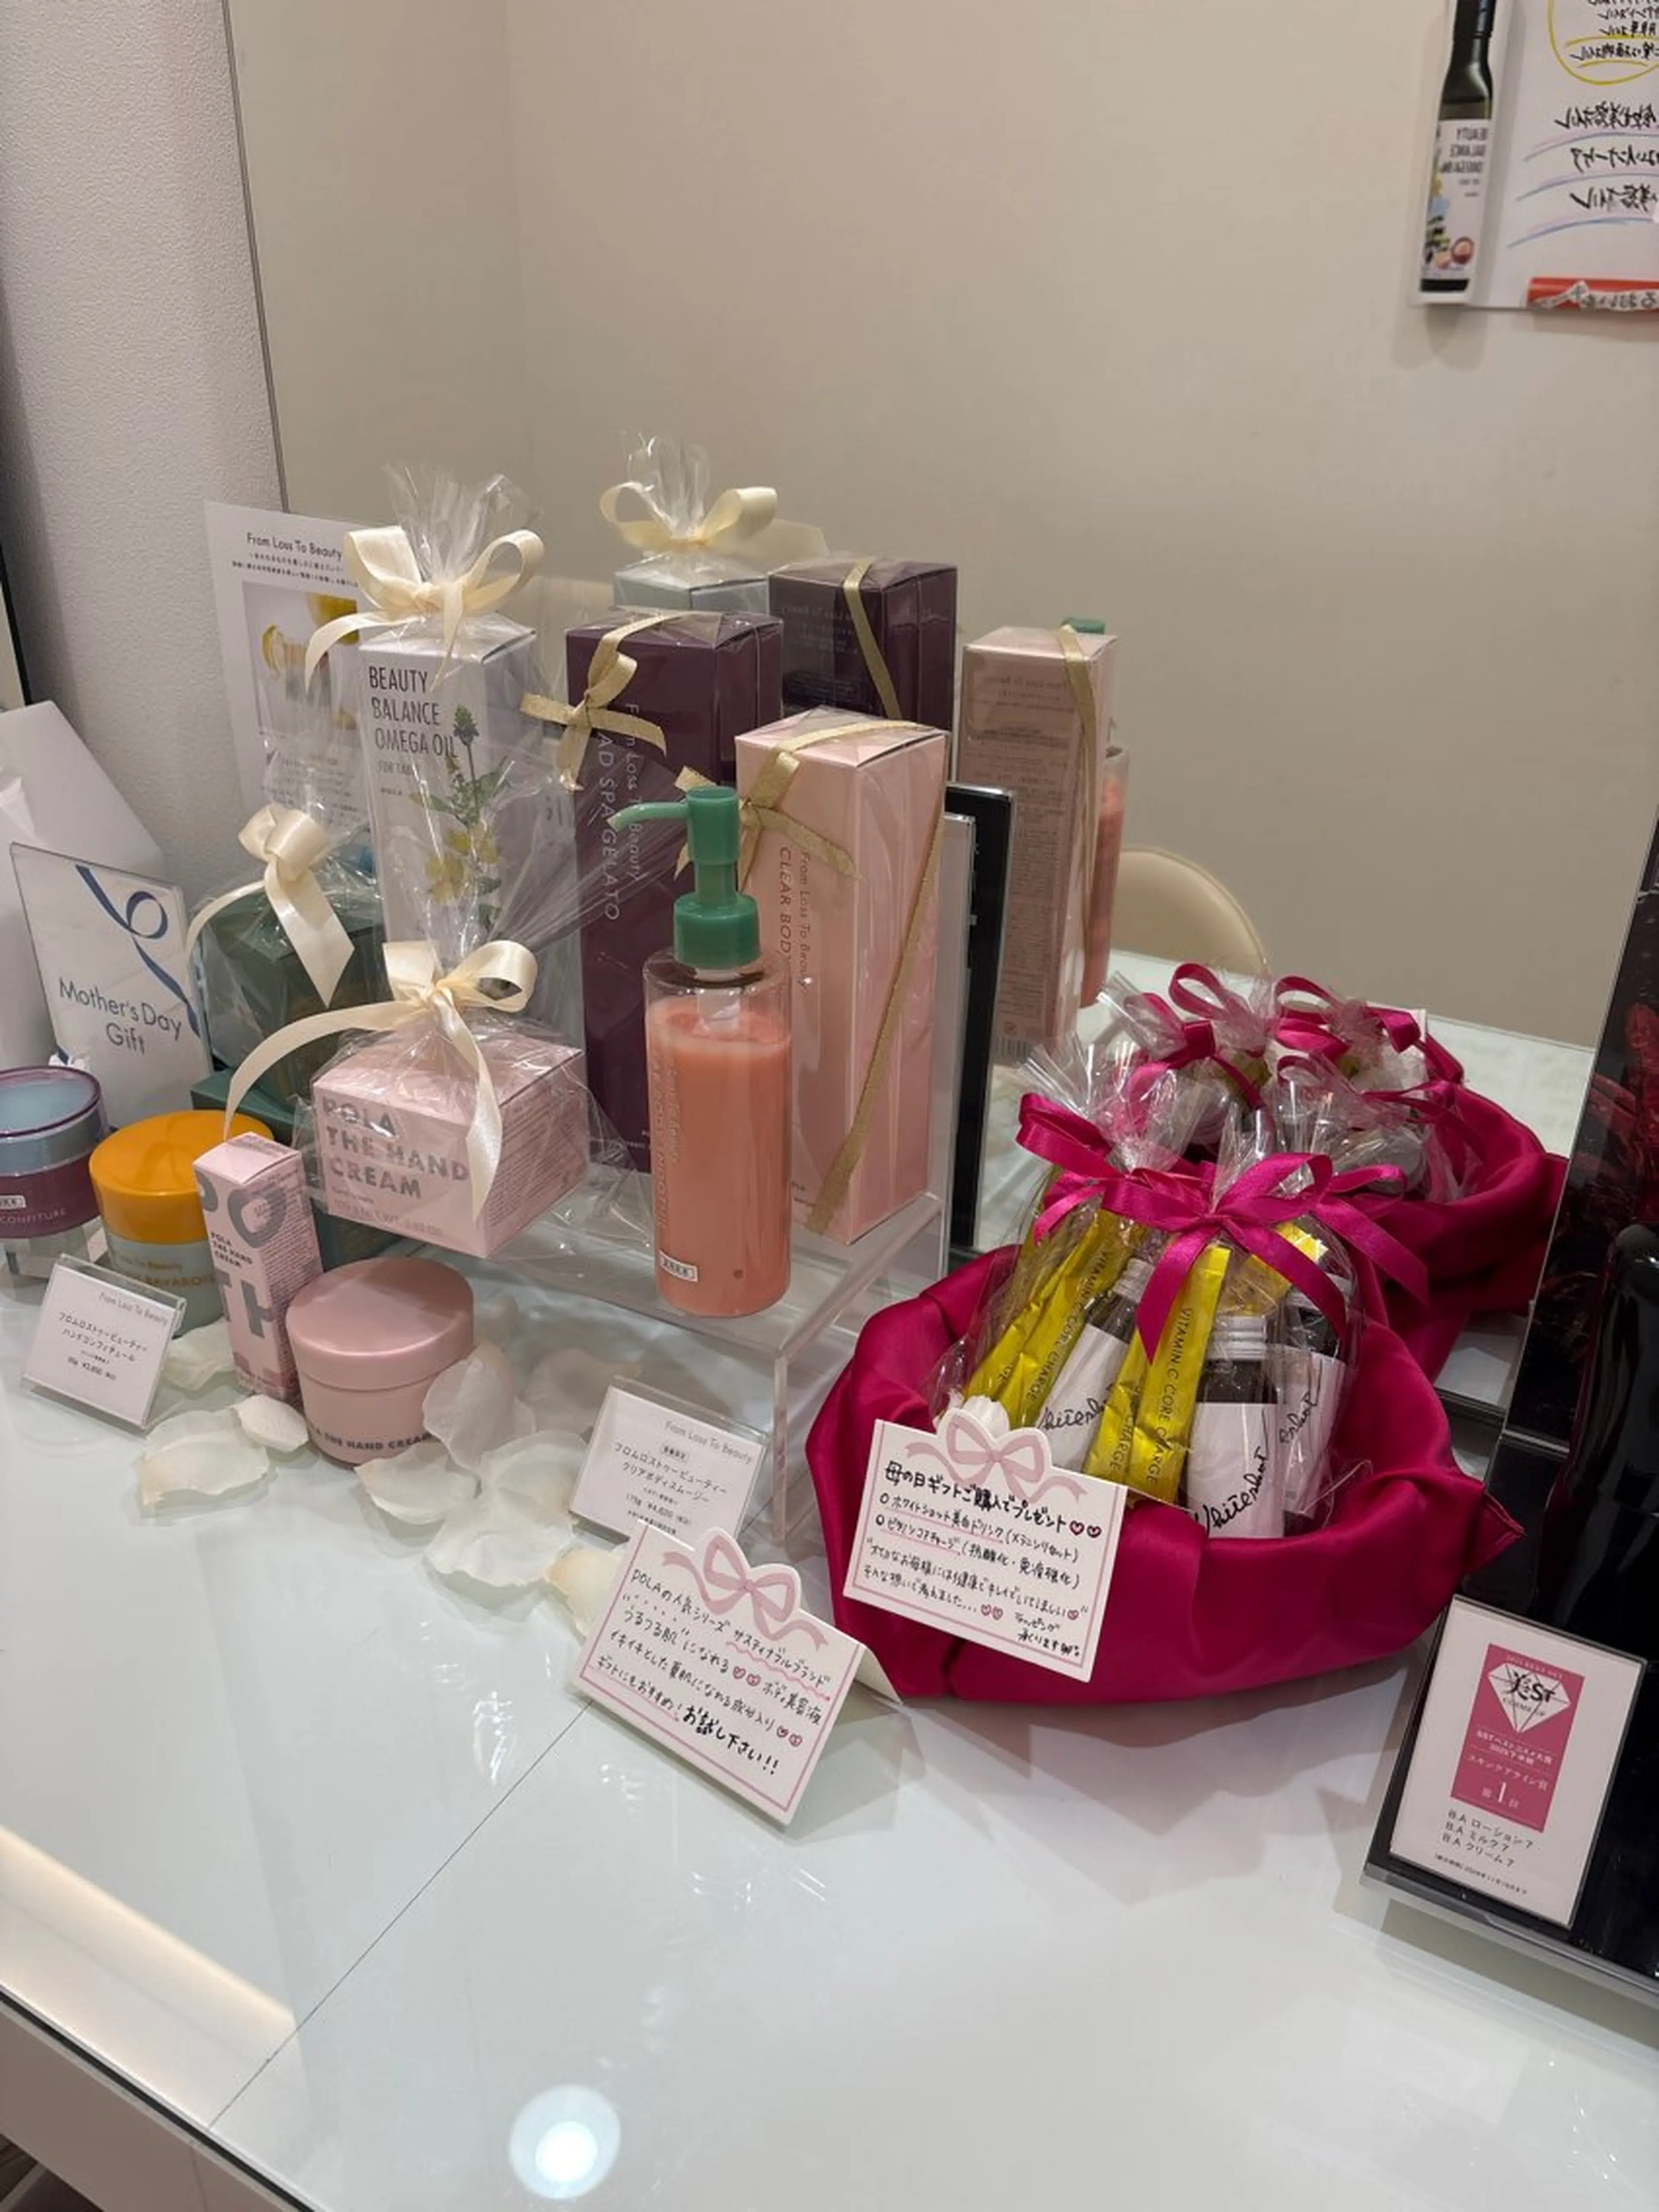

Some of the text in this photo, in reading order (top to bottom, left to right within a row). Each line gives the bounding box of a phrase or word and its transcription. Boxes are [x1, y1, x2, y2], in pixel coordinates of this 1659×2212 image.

[247, 532, 342, 561] From Loss To Beauty
[369, 666, 428, 693] BEAUTY
[372, 696, 441, 726] BALANCE
[375, 728, 458, 759] OMEGA OIL
[599, 779, 616, 817] SPA
[779, 846, 791, 906] CLEAR
[800, 852, 810, 886] From
[800, 890, 810, 918] Loss
[799, 923, 811, 940] To
[59, 977, 181, 1041] Mother's Day
[106, 1022, 145, 1054] Gift
[323, 1096, 396, 1138] POLA
[327, 1126, 468, 1181] THE HAND
[331, 1158, 421, 1198] CREAM
[1170, 1307, 1192, 1364] VITAMIN
[1026, 1350, 1060, 1401] CHARGE
[1168, 1367, 1179, 1380] C
[1158, 1384, 1175, 1424] CORE
[347, 1440, 384, 1450] HAND
[884, 1459, 1067, 1534] 母の日ギフトご購入でプレゼント
[630, 1568, 731, 1633] POLAの人気シリーズ
